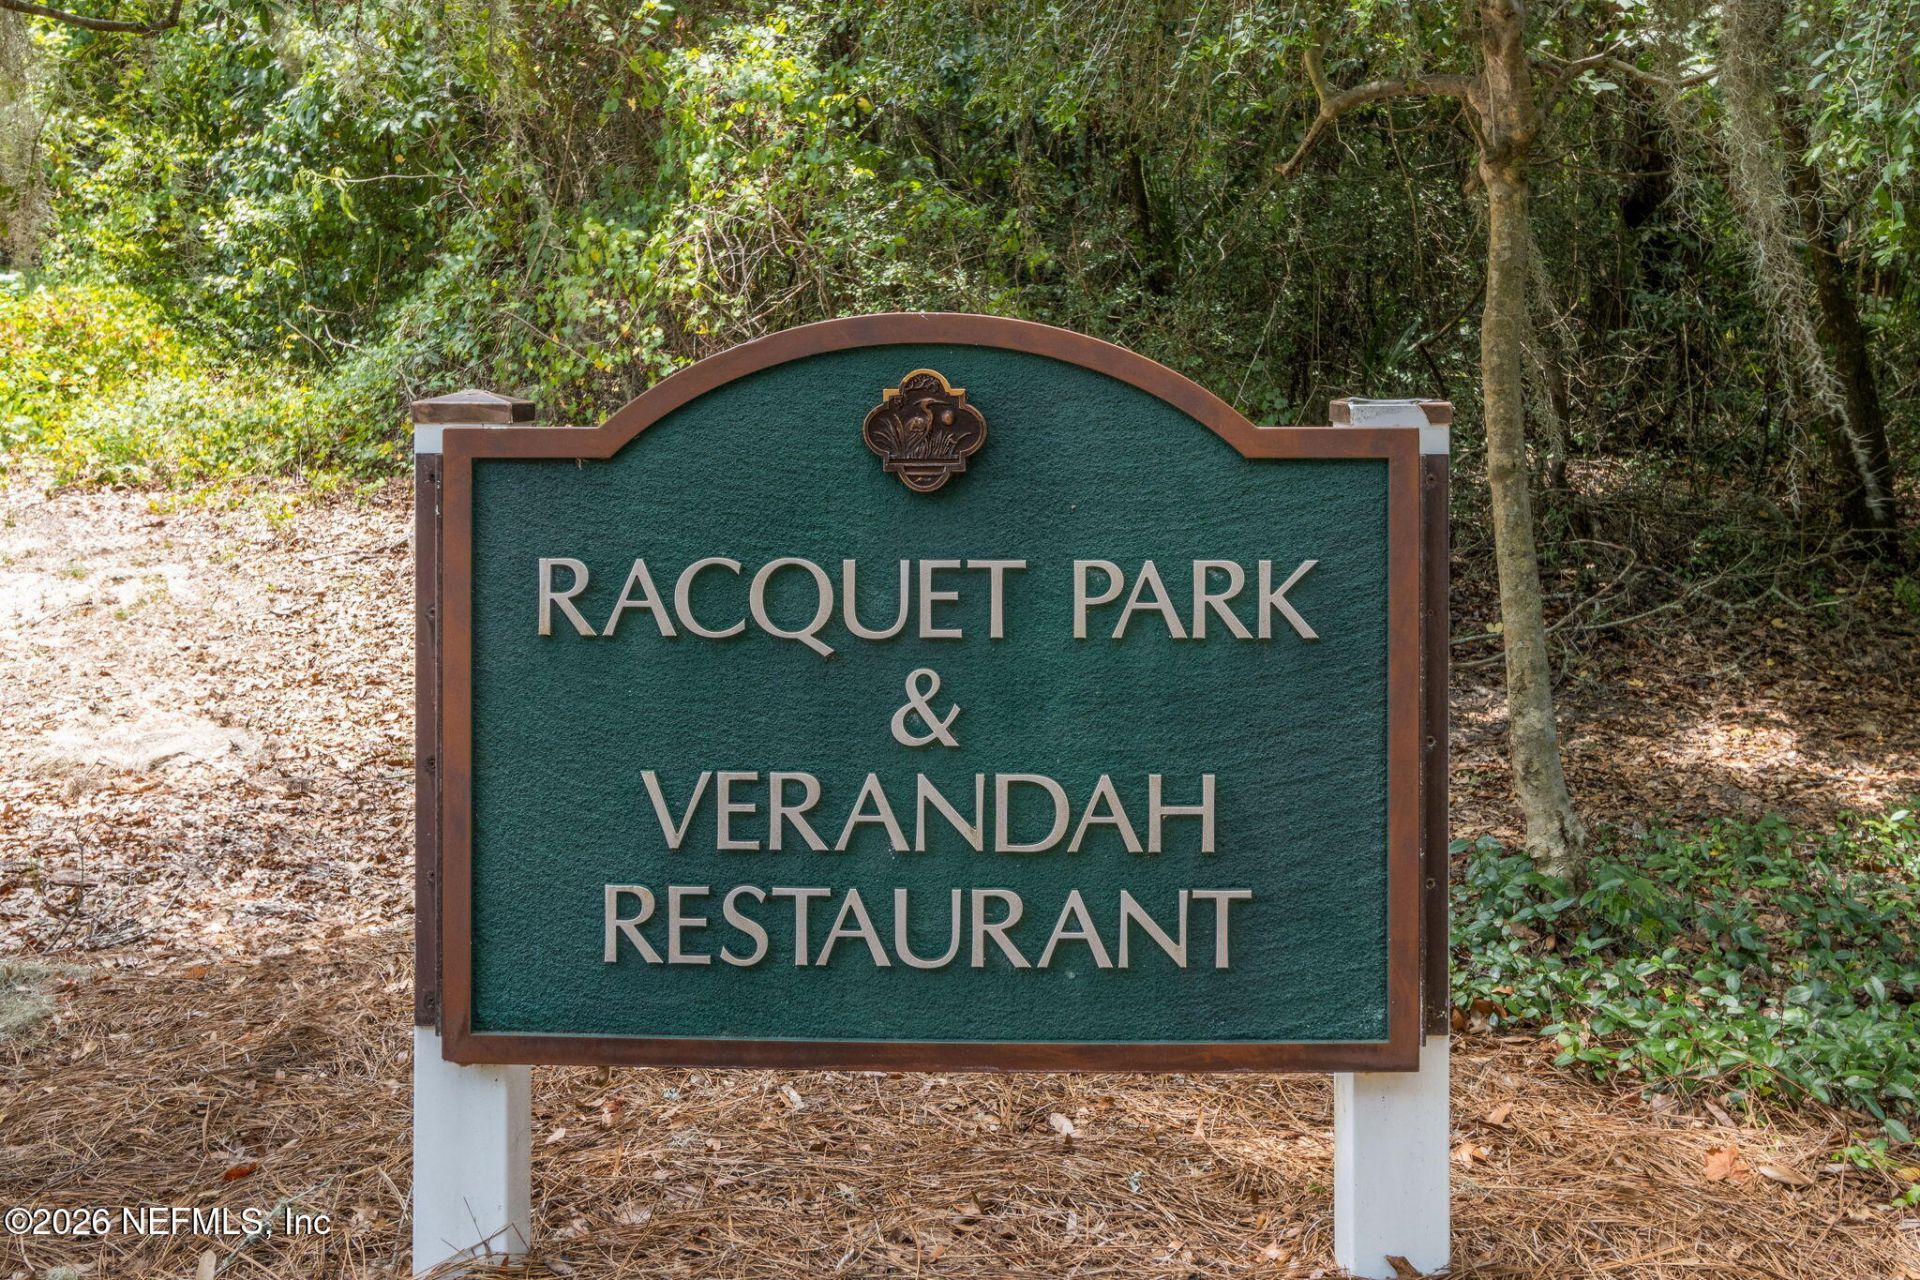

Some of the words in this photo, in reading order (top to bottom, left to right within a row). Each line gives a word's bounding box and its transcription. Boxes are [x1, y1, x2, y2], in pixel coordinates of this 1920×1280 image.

[537, 556, 1027, 657] RACQUET
[1073, 559, 1319, 640] PARK
[890, 667, 961, 748] &
[640, 770, 1217, 853] VERANDAH
[603, 883, 1254, 969] RESTAURANT
